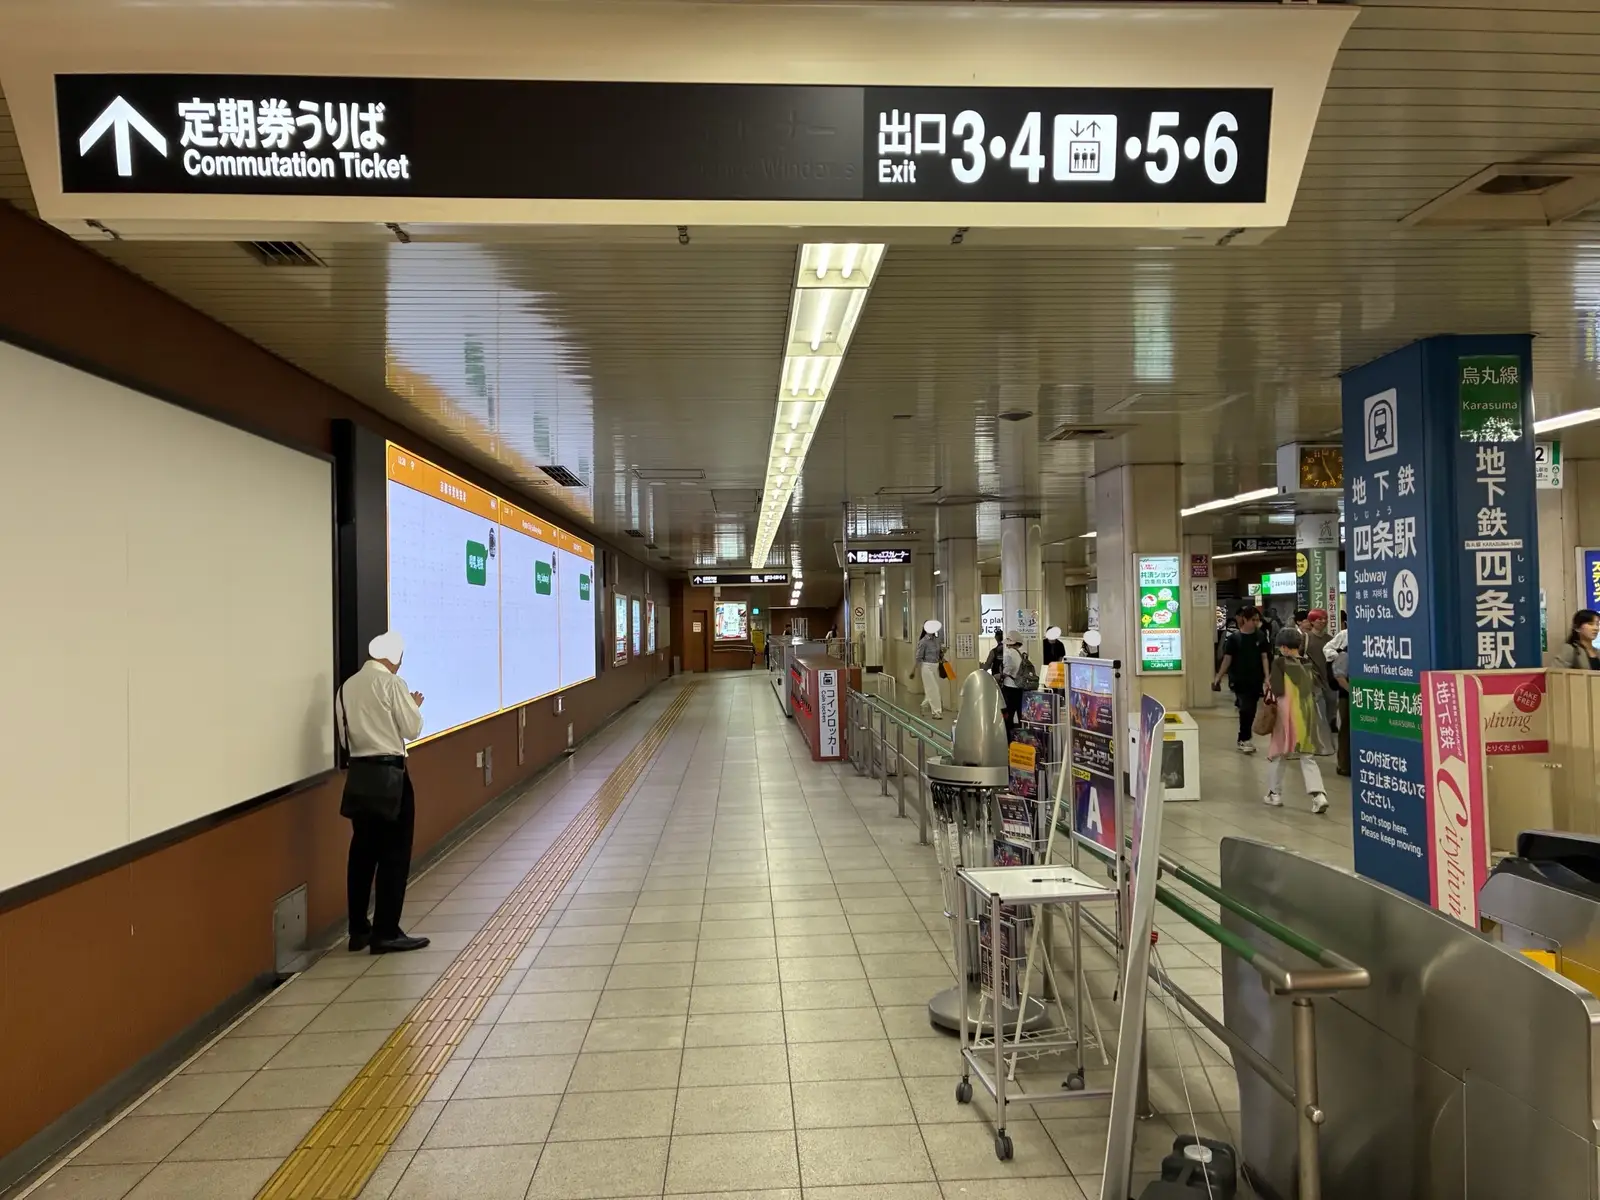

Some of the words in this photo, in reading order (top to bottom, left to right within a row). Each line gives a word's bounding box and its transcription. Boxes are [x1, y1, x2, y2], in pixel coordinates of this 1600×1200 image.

[178, 96, 388, 151] 定期券うりば
[878, 109, 946, 156] 出口
[183, 149, 336, 180] Commutation
[341, 152, 411, 180] Ticket
[878, 158, 917, 184] Exit
[1461, 365, 1519, 385] 烏丸線
[1462, 401, 1518, 411] Karasuma
[1351, 464, 1416, 505] 地下鉄
[1475, 446, 1508, 537] 地下鉄
[1353, 505, 1392, 521] しじょう
[1353, 516, 1417, 562] 四条駅
[1354, 568, 1388, 584] Subway
[1401, 574, 1409, 589] K
[1397, 588, 1414, 612] 09
[1475, 550, 1517, 669] 四条駅
[1354, 604, 1376, 622] Shijo
[1377, 605, 1394, 619] Sta.
[1361, 634, 1412, 660] 北改札口
[1363, 663, 1380, 674] North
[1380, 664, 1398, 676] Ticket
[1398, 666, 1414, 677] Gate
[1352, 686, 1386, 711] 地下鉄
[1517, 696, 1536, 708] FREE
[1519, 688, 1538, 701] TAKE
[826, 689, 837, 755] コインロッカー
[1436, 680, 1456, 749] 地下鉄
[1359, 749, 1408, 773] この付近では
[1359, 768, 1426, 800] 立ち止まらないで
[1086, 785, 1103, 835] A
[1360, 788, 1396, 812] ください。
[1360, 811, 1378, 824] Don't
[1378, 818, 1392, 832] stop
[1392, 820, 1409, 836] here.
[1361, 825, 1380, 841] Please
[1380, 831, 1396, 848] keep
[1396, 839, 1424, 858] moving.
